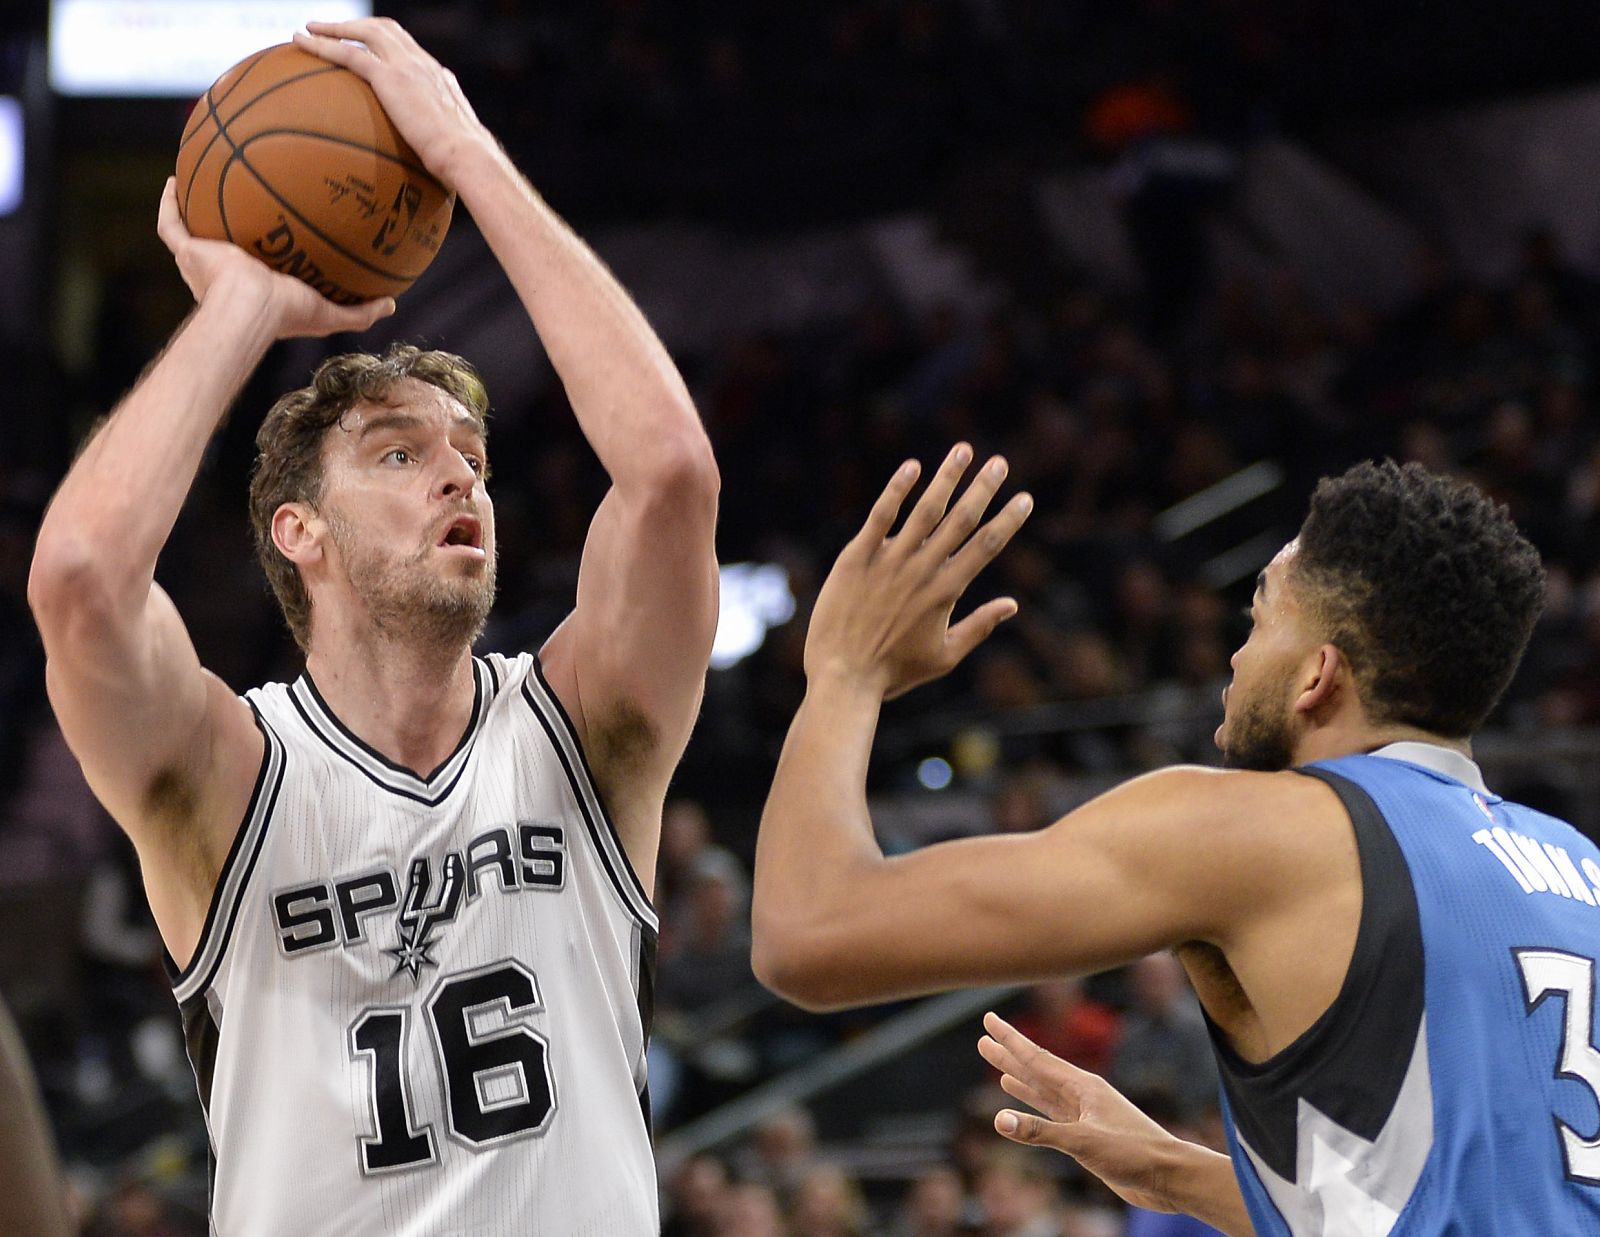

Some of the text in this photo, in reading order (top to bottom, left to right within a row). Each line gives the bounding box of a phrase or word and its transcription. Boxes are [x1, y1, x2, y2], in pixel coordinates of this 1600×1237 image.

[271, 822, 567, 962] SPURS
[348, 957, 558, 1176] 16
[1510, 947, 1600, 1187] 3
